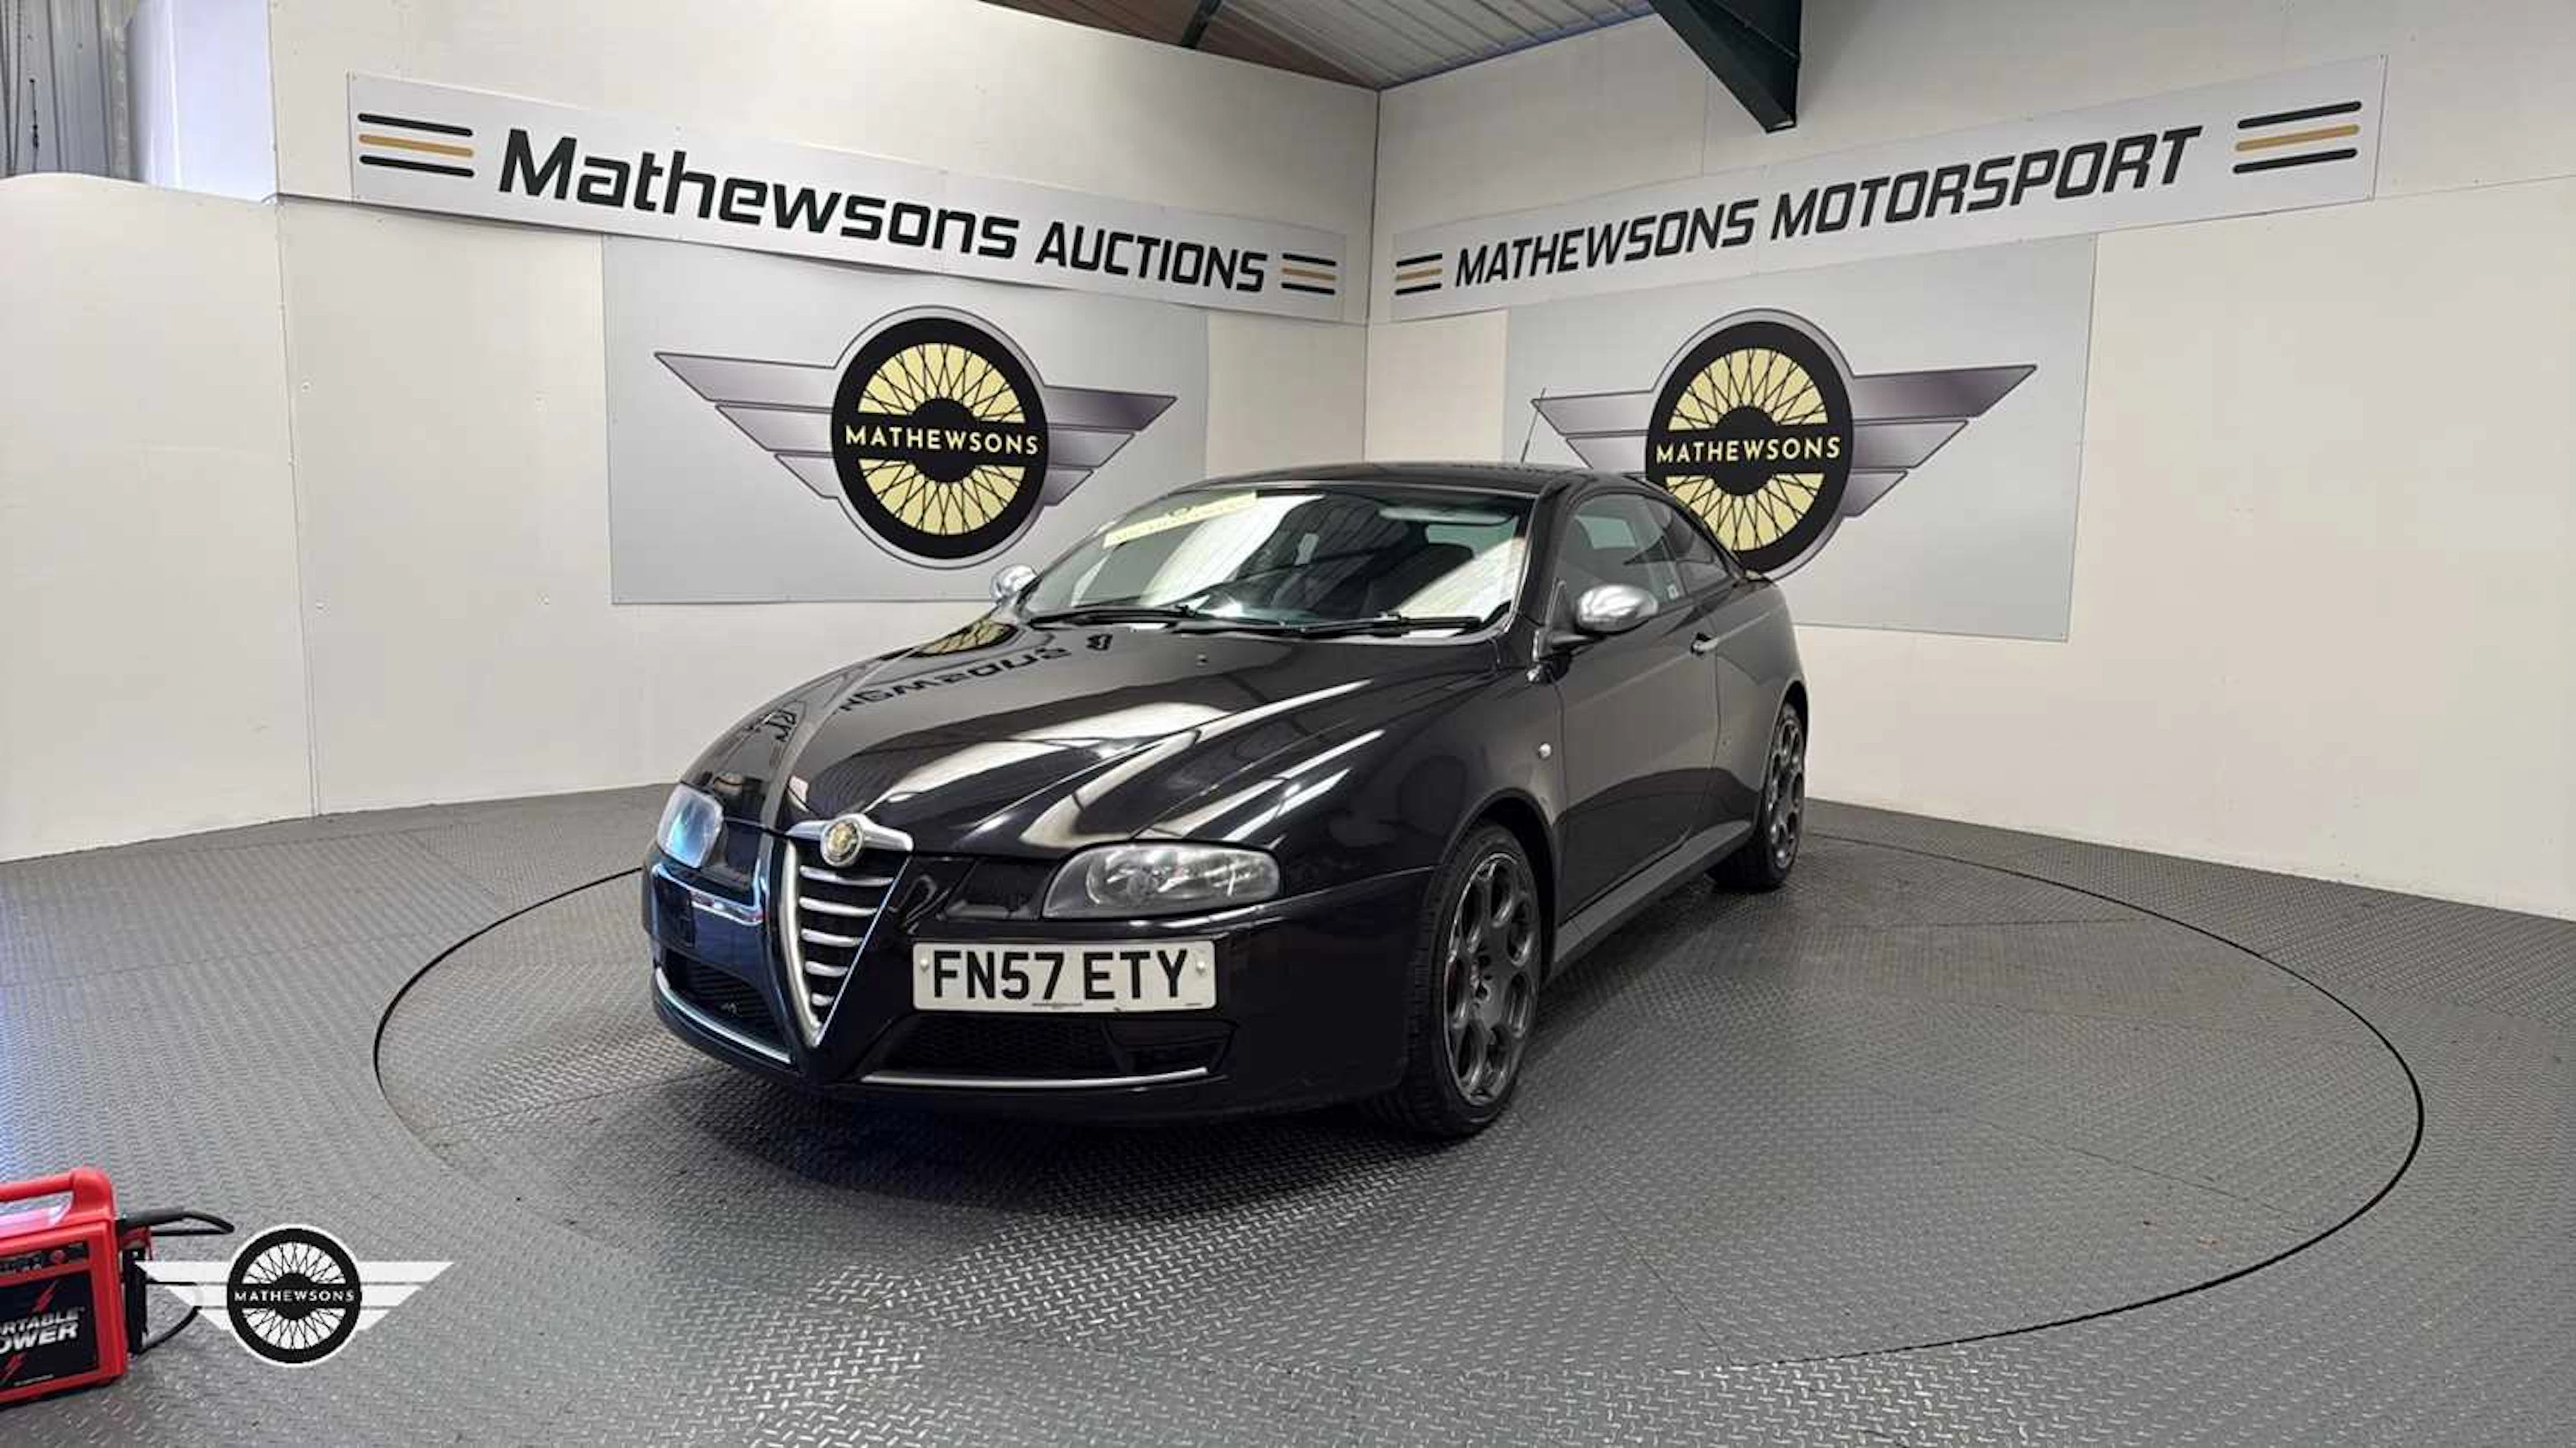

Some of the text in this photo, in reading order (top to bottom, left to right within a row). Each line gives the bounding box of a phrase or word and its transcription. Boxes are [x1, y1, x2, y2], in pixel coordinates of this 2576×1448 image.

[498, 127, 1269, 293] Mathewsons AUCTIONS
[1454, 125, 2204, 288] MATHEWSONS MOTORSPORT
[845, 424, 1039, 455] MATHEWSONS
[1656, 435, 1841, 464] MATHEWSONS
[933, 948, 1189, 1000] FN57 ETY
[0, 1309, 79, 1335] RTABLE
